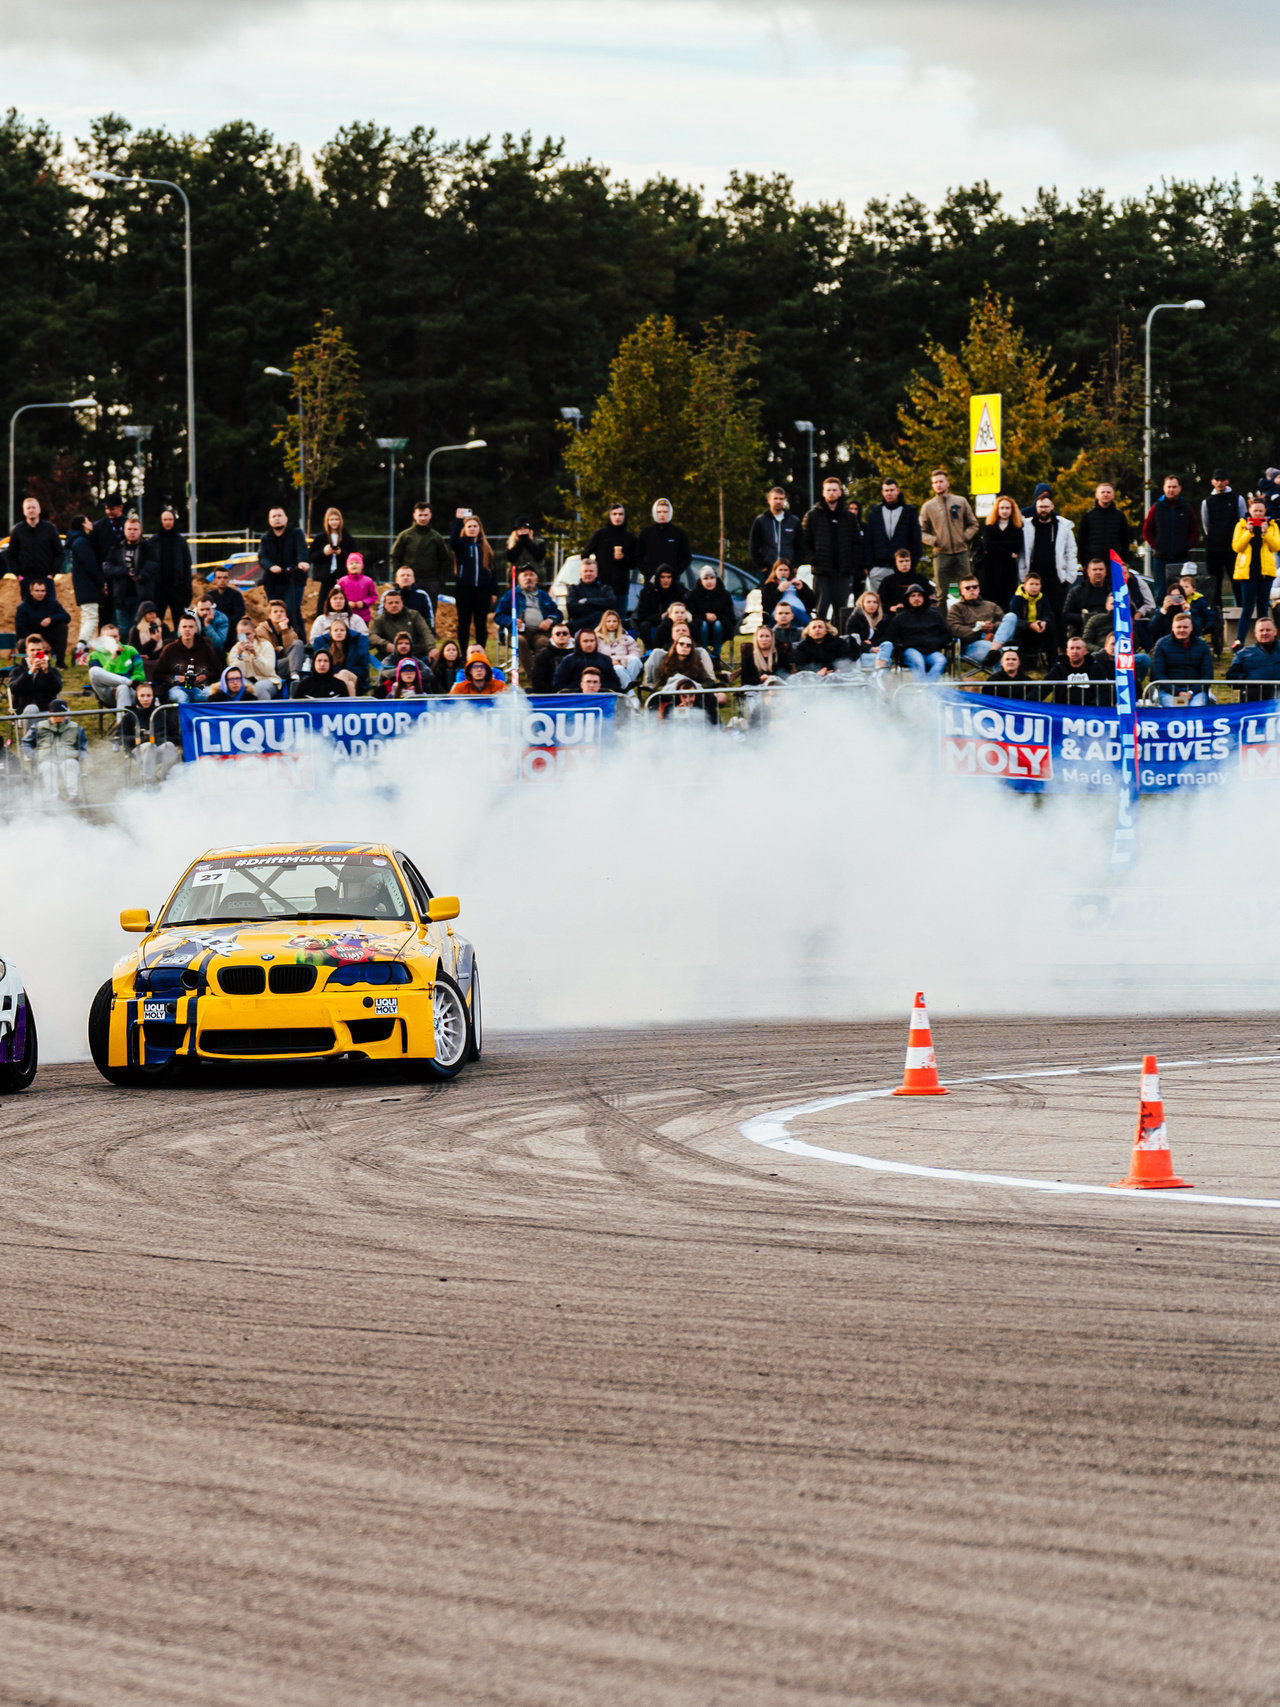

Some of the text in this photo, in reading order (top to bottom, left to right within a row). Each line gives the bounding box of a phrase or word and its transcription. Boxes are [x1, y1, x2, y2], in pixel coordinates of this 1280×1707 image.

[322, 711, 476, 736] MOTOR OILS
[491, 713, 595, 746] LIQUI
[945, 705, 1044, 743] LIQUI
[1062, 717, 1230, 739] MOTR OILS
[200, 717, 307, 754] LIQUI
[945, 740, 1048, 776] MOLY
[1061, 738, 1229, 761] & ADITIVES
[1063, 768, 1229, 787] Made Germany
[199, 873, 223, 882] 27
[375, 998, 397, 1006] LIQUI
[376, 1006, 397, 1014] MOLY
